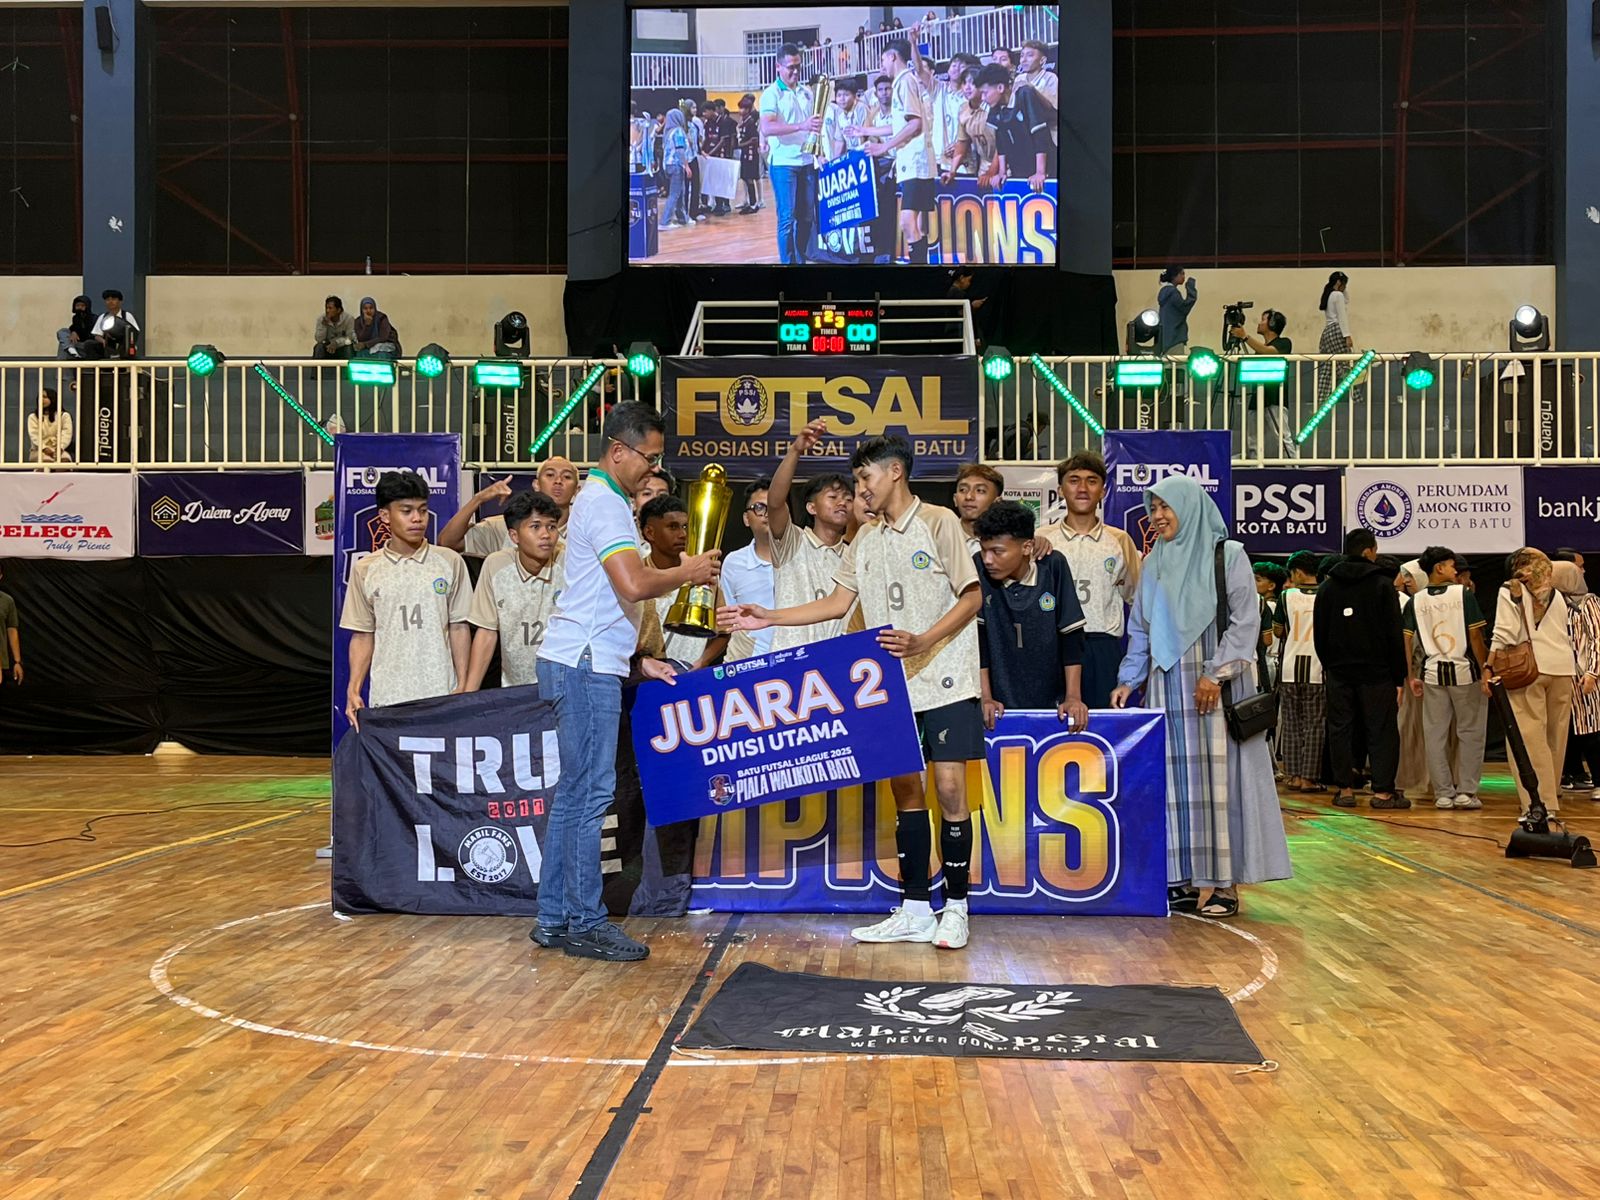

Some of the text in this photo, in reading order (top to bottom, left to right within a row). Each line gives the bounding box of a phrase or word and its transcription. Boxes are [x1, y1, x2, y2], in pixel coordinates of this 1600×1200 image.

[818, 158, 868, 201] JUARA 2
[814, 315, 822, 328] 1
[823, 310, 834, 323] 2
[834, 315, 845, 328] 3
[780, 323, 810, 343] 03
[846, 323, 877, 343] 00
[786, 343, 801, 351] TEAM
[850, 343, 865, 351] TEAM
[676, 376, 969, 436] FUTSAL
[677, 440, 769, 457] ASOSIASI
[774, 440, 851, 457] FSAL
[914, 439, 966, 457] BATU
[346, 466, 447, 488] FUAL
[1003, 490, 1041, 498] KOTA BATU
[1116, 485, 1218, 493] ASOSIAS ATU
[1417, 484, 1508, 497] PERUMDAM
[1236, 483, 1325, 521] PSSI
[1416, 501, 1512, 513] AMONG TIRTO
[181, 500, 291, 525] Dalem Ageng
[0, 525, 113, 538] ELECTA
[1236, 522, 1327, 534] KOTA BATU
[1417, 518, 1512, 529] KOTA BATU
[43, 539, 111, 553] Truly Picnic
[888, 581, 904, 611] 9
[1073, 579, 1091, 605] 3
[399, 603, 423, 631] 14
[521, 620, 544, 646] 12
[1013, 623, 1023, 649] 1
[1431, 619, 1456, 656] 6
[735, 658, 768, 672] FUTSAL
[650, 658, 889, 754] JUARA 2
[702, 718, 849, 767] DIVISI UTAMA
[399, 729, 561, 794] TRU
[736, 746, 853, 778] BATU FUTSAL LEAGUE 2025
[736, 755, 862, 804] PIALA WALIKOTA BATU
[710, 785, 735, 798] BTU
[488, 798, 545, 818] 2017
[464, 829, 513, 849] MABIL FANS
[470, 868, 508, 882] EST 2017
[850, 1039, 877, 1048] WE
[886, 1034, 948, 1044] NEVER
